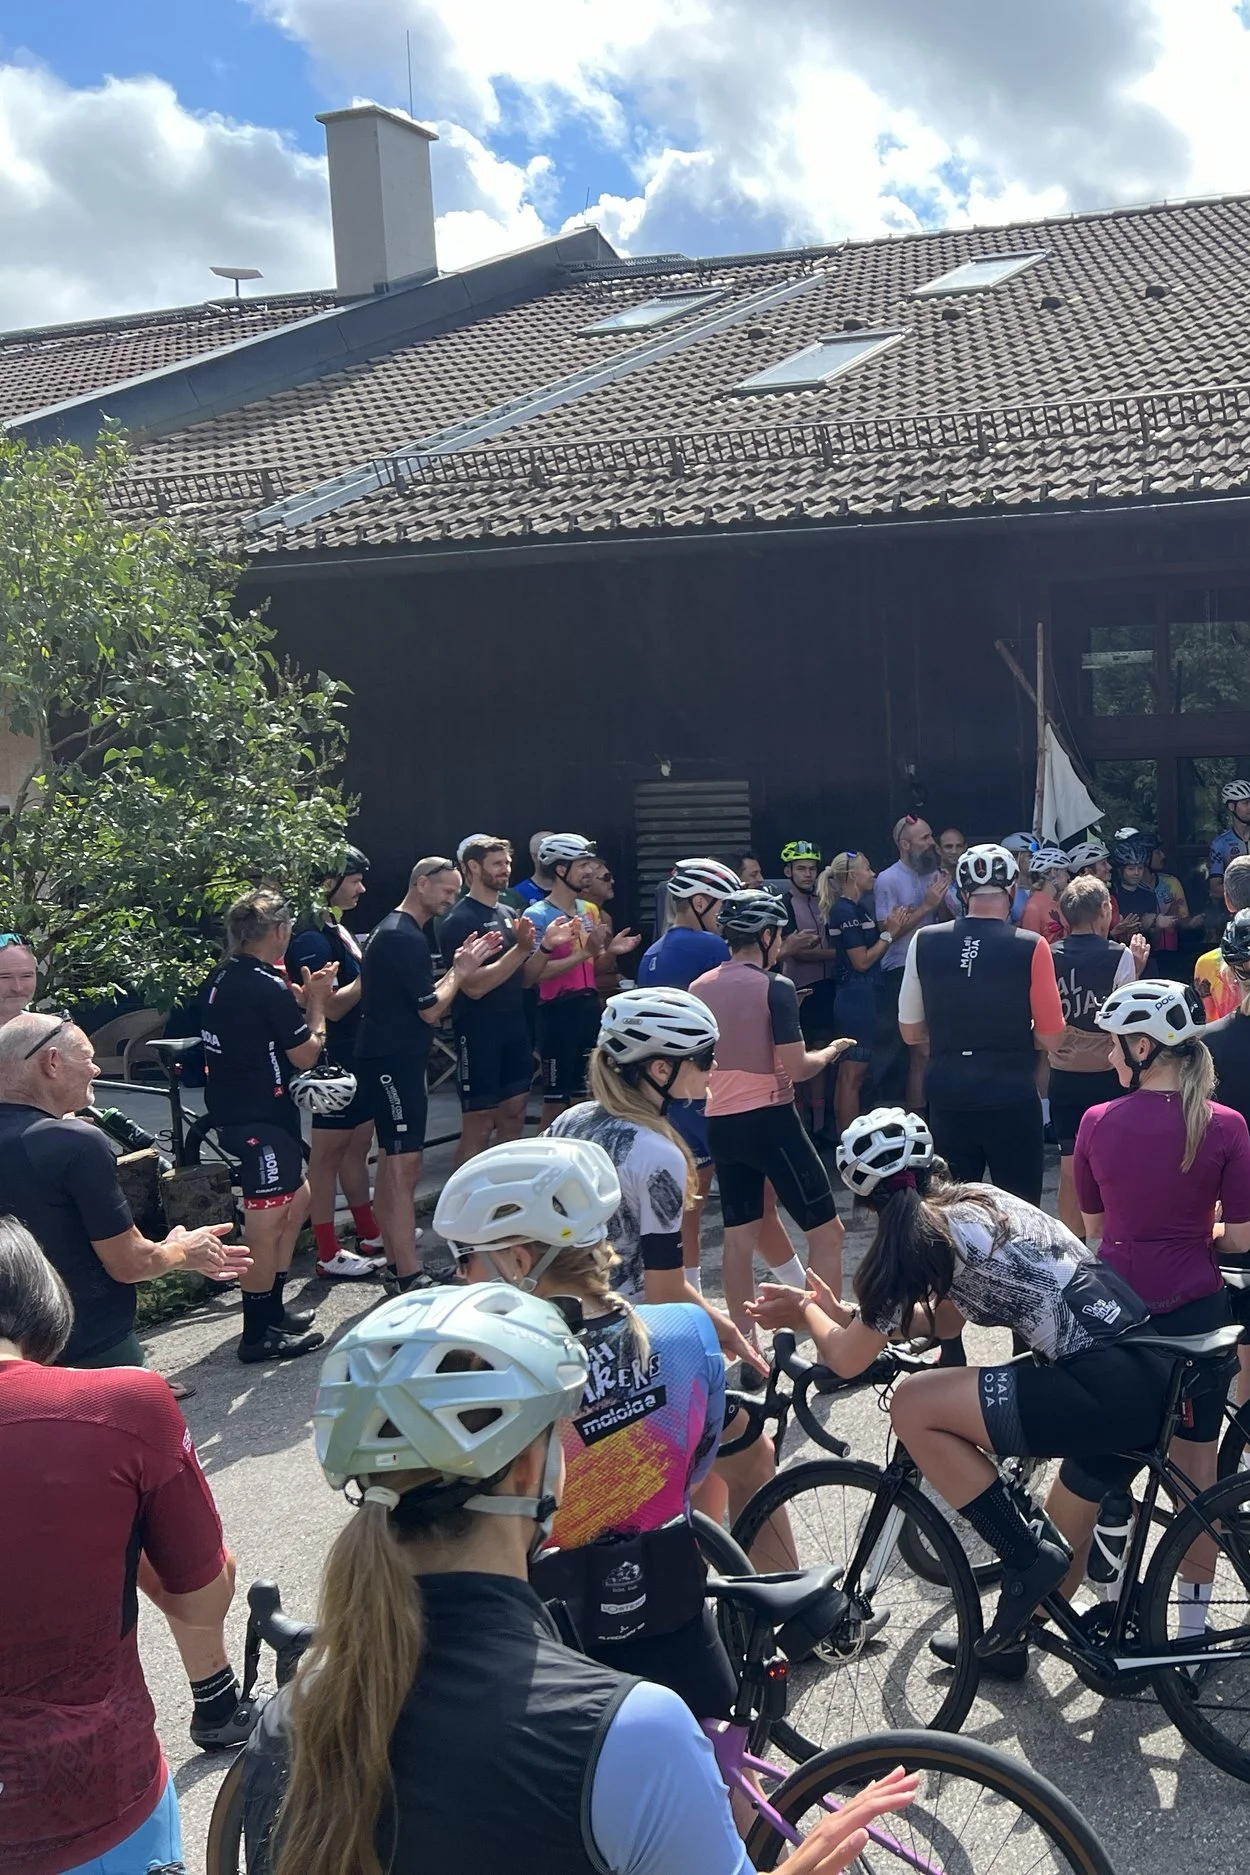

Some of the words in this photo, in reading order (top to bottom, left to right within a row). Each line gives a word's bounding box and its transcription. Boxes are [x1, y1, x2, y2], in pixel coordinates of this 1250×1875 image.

[960, 944, 971, 968] MAL
[970, 939, 981, 959] OJA
[1057, 968, 1082, 996] AL
[264, 1152, 280, 1184] BORA
[984, 1373, 995, 1408] OJA
[997, 1372, 1008, 1406] MAL
[582, 1399, 646, 1437] maloja
